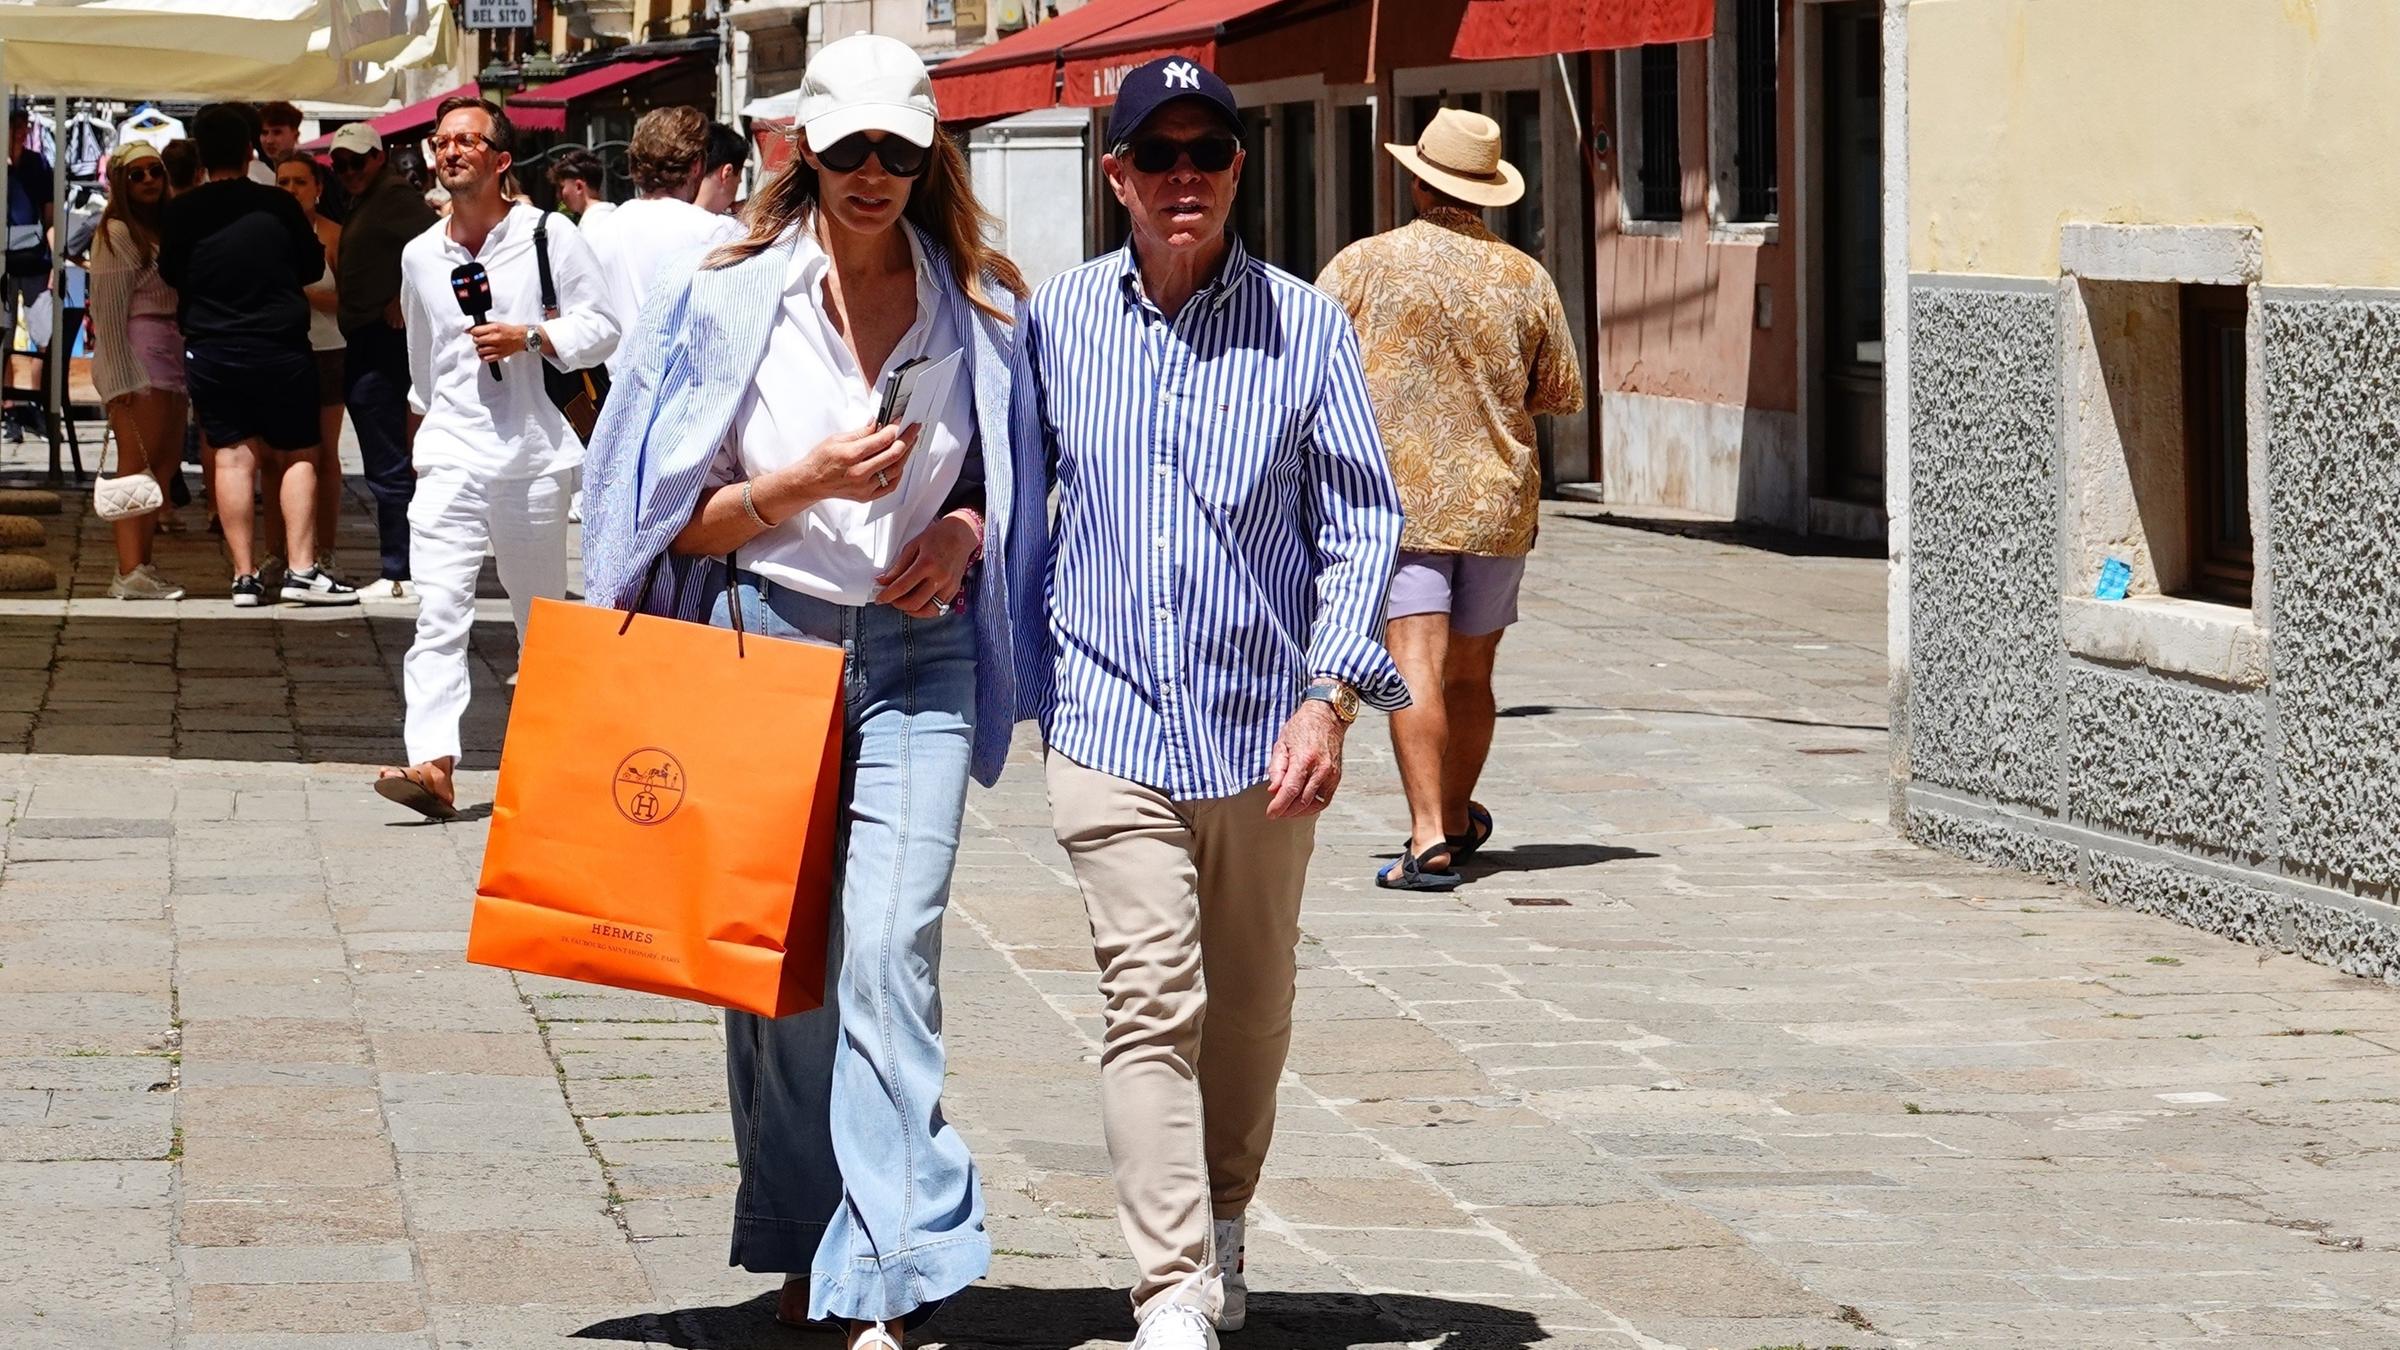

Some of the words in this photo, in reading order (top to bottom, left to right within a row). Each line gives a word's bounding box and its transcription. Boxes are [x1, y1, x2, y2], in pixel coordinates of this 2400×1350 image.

[472, 9, 494, 22] BEL
[499, 9, 526, 22] SITO
[1162, 61, 1200, 90] NY
